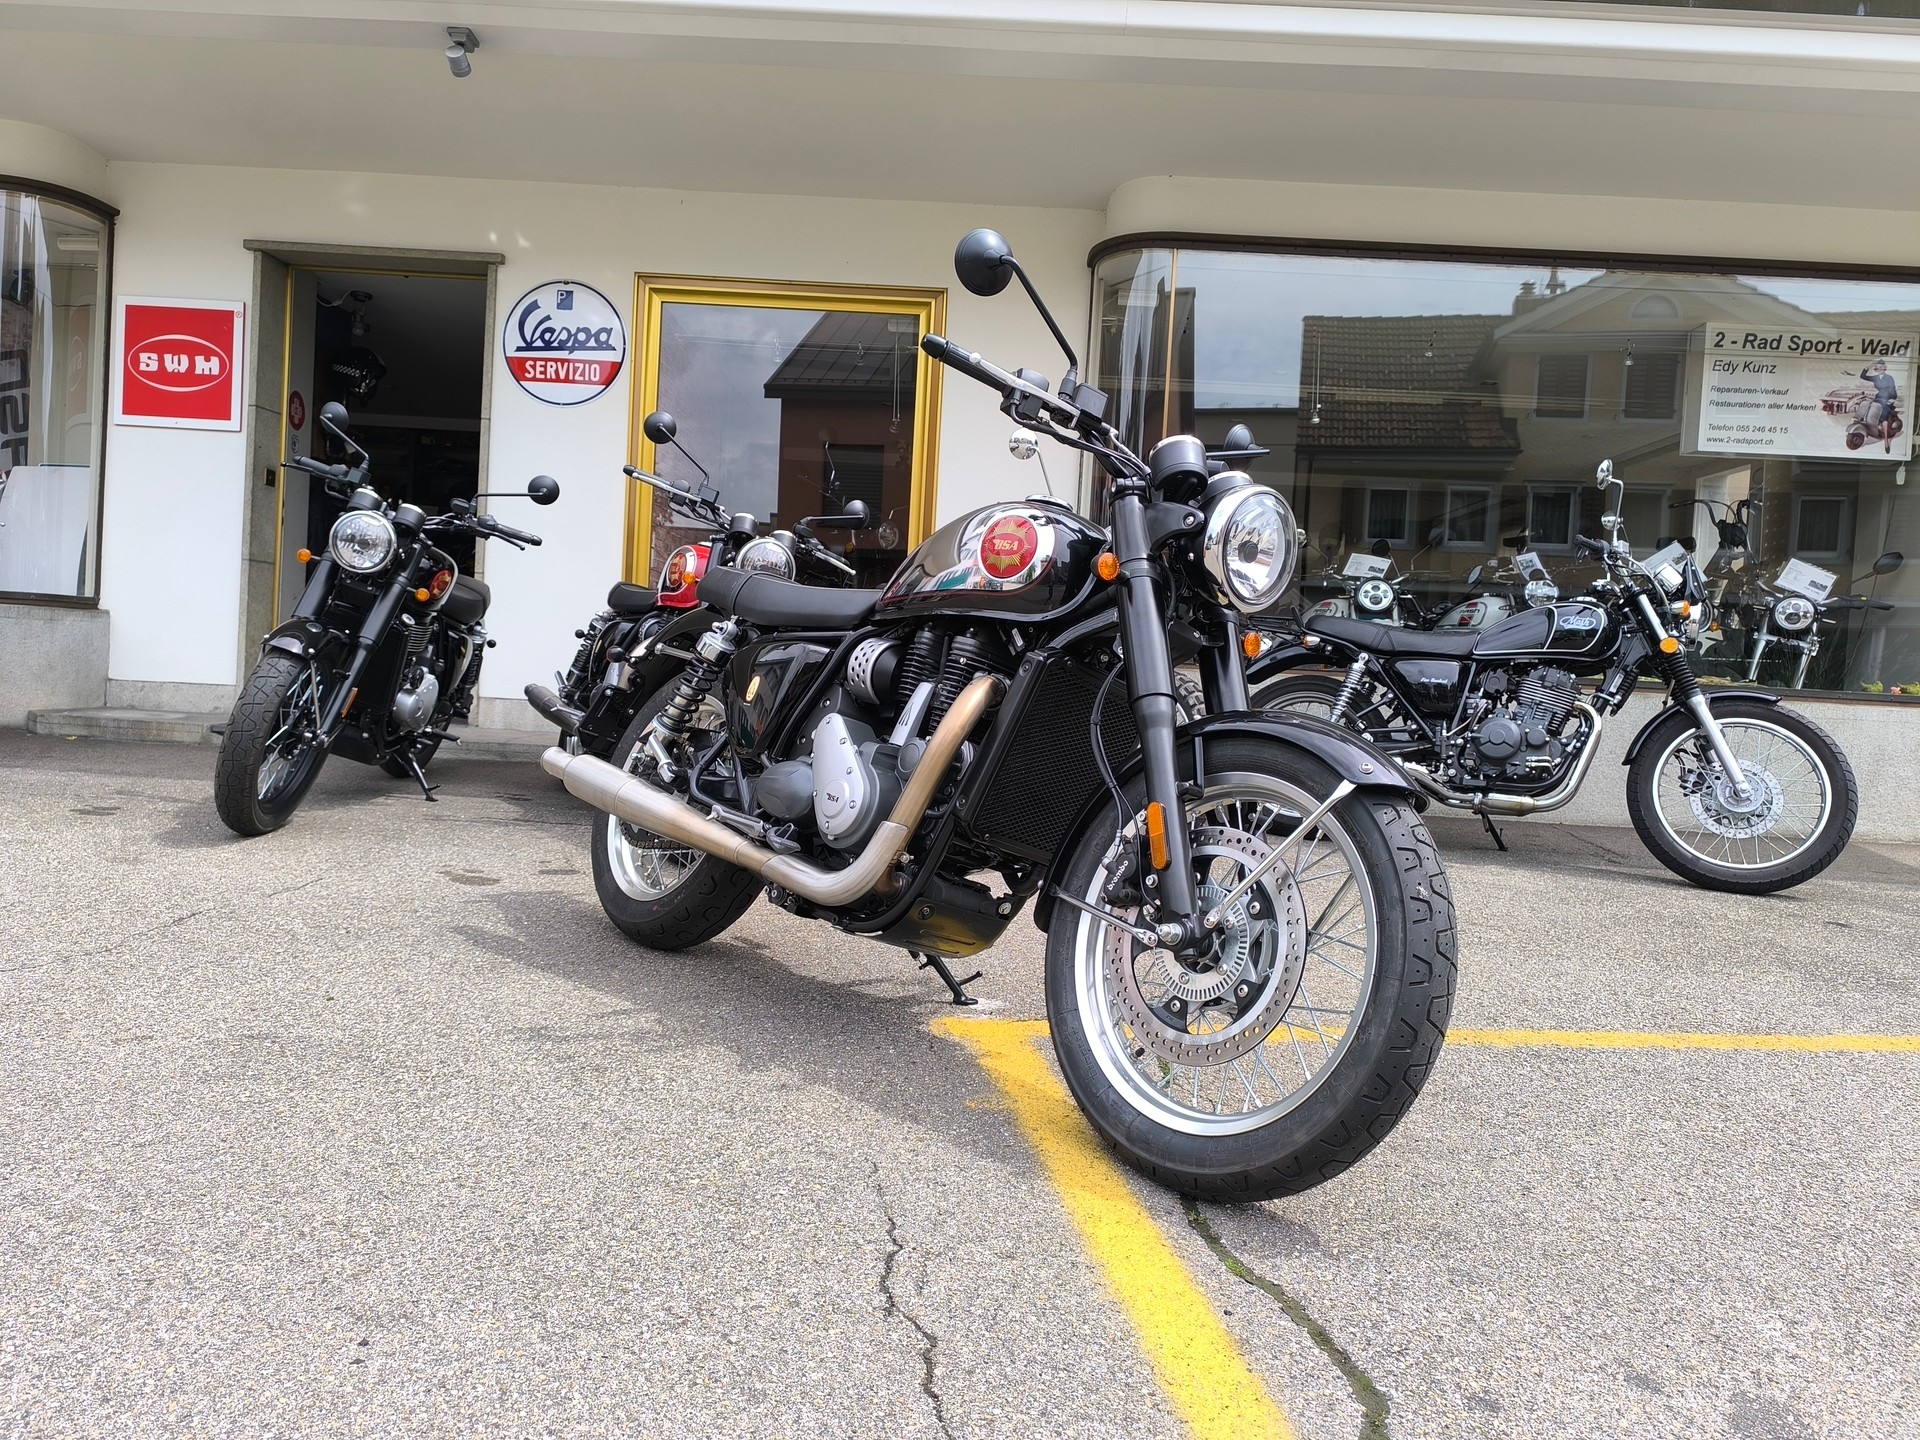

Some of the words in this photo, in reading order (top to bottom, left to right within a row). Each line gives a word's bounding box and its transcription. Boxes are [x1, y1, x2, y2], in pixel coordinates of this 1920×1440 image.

[557, 290, 567, 304] P
[514, 299, 617, 355] Vespa
[1713, 331, 1725, 348] 2
[1742, 333, 1783, 350] Rad
[1788, 335, 1843, 355] Sport
[1861, 338, 1910, 356] Wald
[138, 352, 220, 376] SWM
[524, 360, 601, 382] SERVIZIO
[1712, 360, 1740, 375] Edy
[1742, 361, 1777, 374] Kunz
[1710, 385, 1789, 397] Reparaturen-Verkauf
[1709, 400, 1766, 410] Restaurationen
[1767, 402, 1784, 411] aller
[1786, 403, 1817, 412] Marken!
[1708, 423, 1734, 433] Telefon
[1736, 425, 1750, 433] 055
[1752, 425, 1766, 433] 246
[1767, 426, 1778, 434] 45
[1779, 426, 1789, 434] 15
[1706, 436, 1774, 446] www.2-radsport.ch
[992, 538, 1019, 551] BSA
[1106, 860, 1129, 891] brembo
